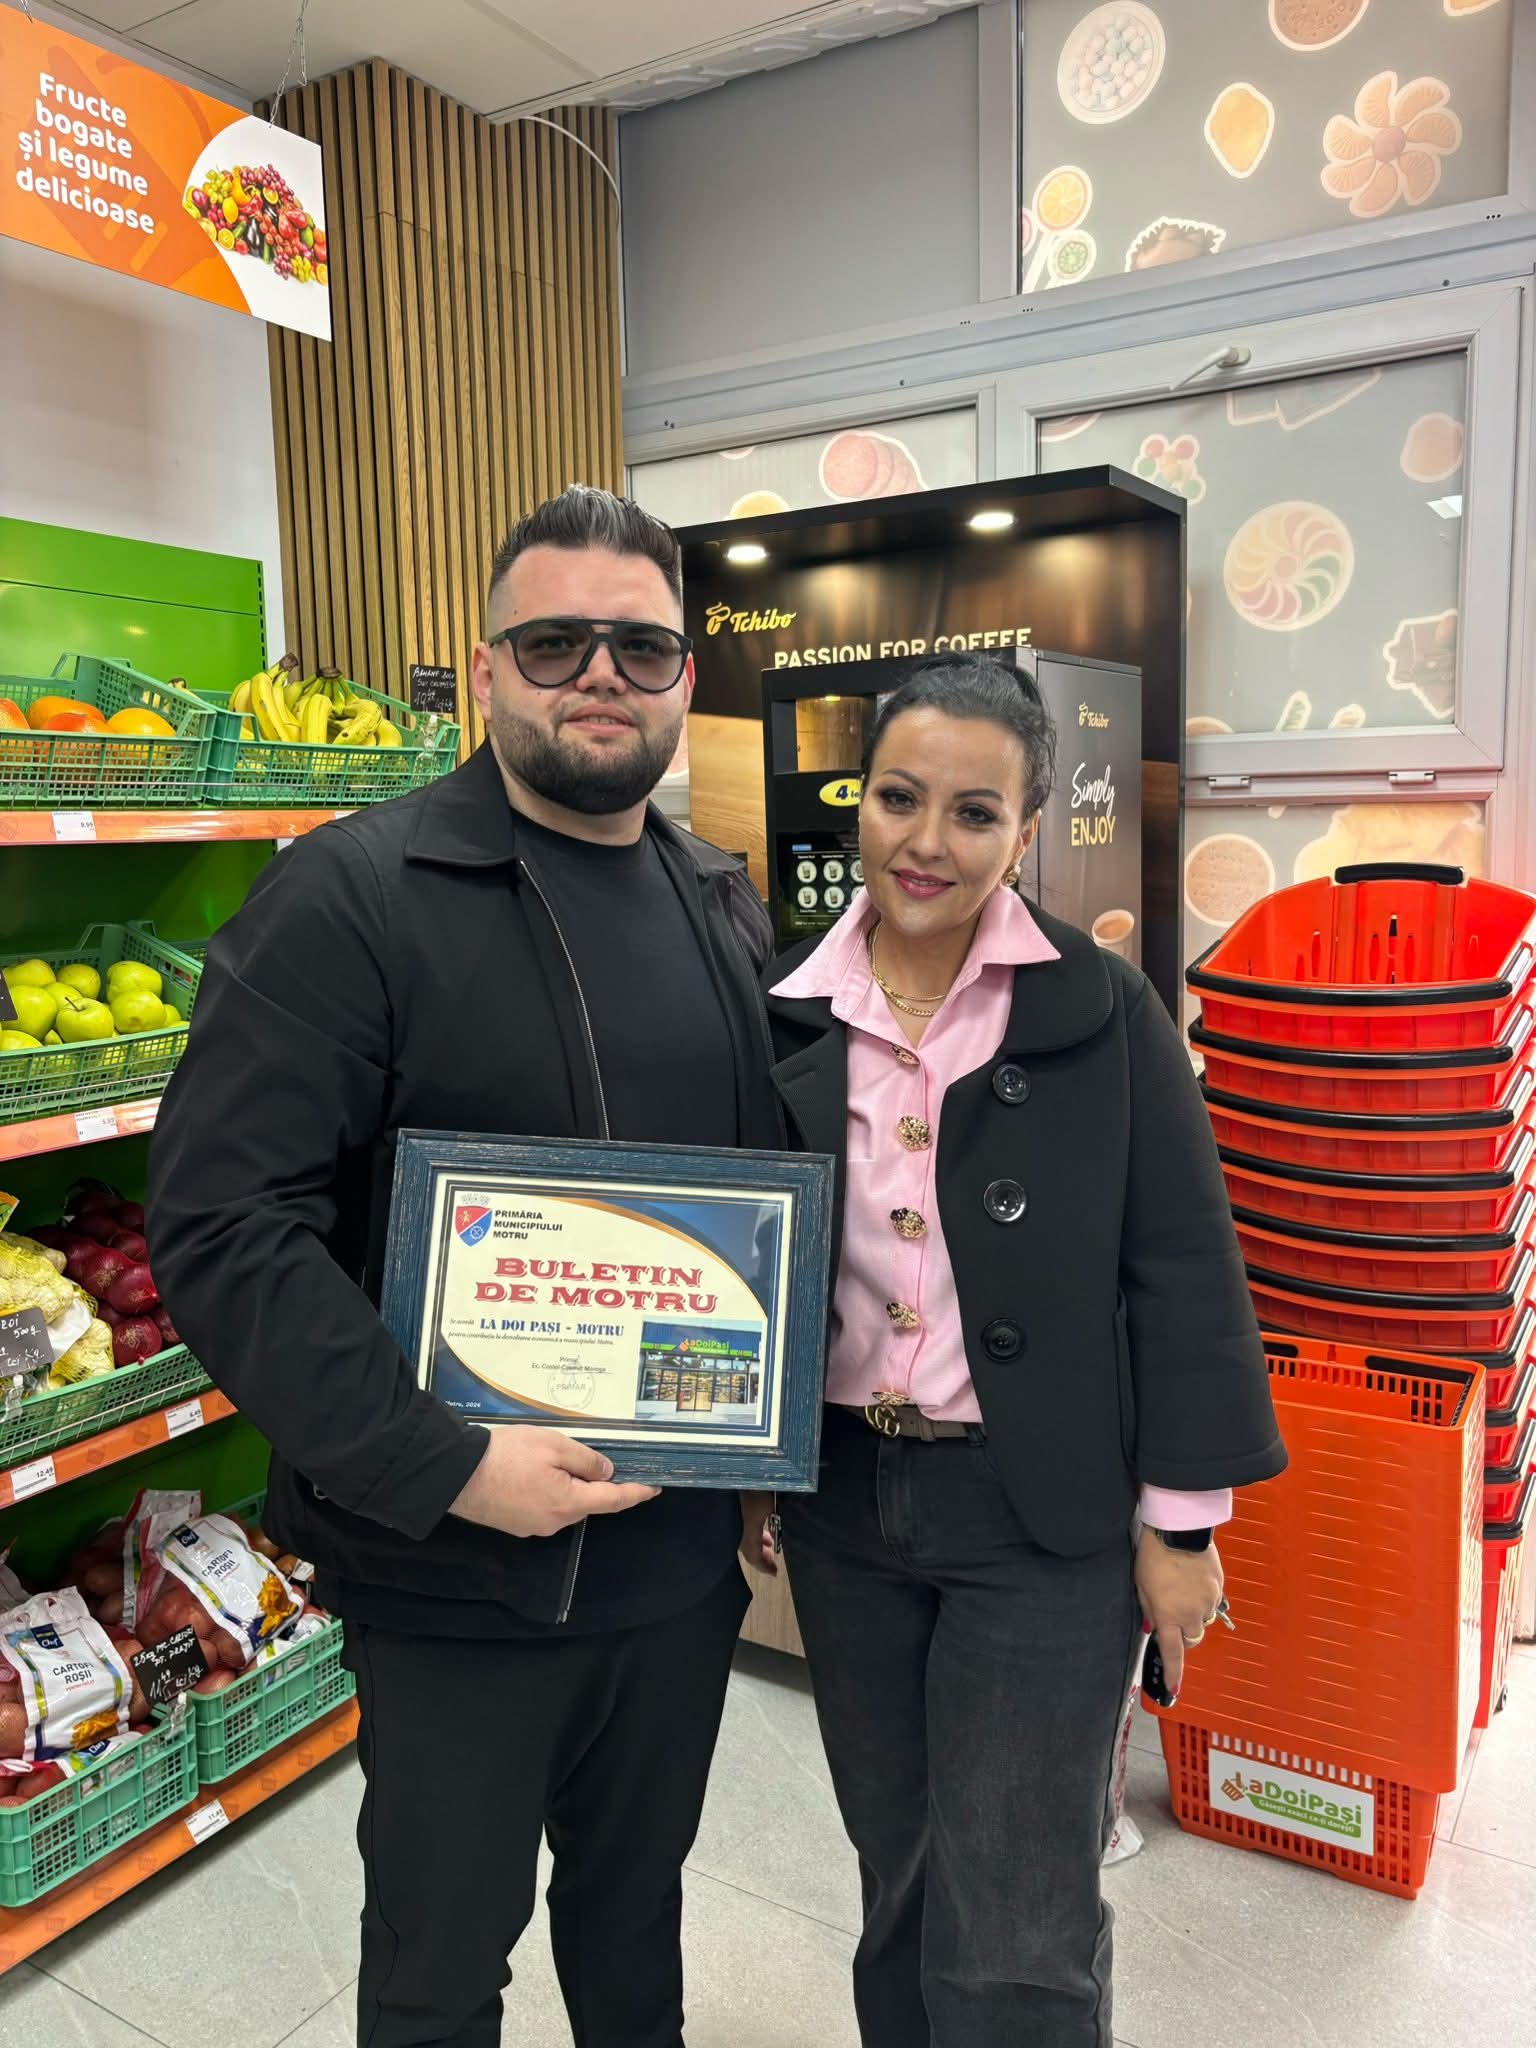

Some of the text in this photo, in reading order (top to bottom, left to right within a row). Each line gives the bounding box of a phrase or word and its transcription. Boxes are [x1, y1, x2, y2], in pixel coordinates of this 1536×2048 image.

[40, 72, 127, 128] Fructe
[36, 98, 132, 159] bogate
[18, 129, 148, 196] și legume
[16, 167, 155, 234] delicioase
[729, 608, 797, 633] Tchibo
[774, 643, 872, 669] PASSION
[879, 639, 926, 659] FOR
[1087, 711, 1110, 728] Tchibo
[835, 785, 849, 801] 4
[1071, 762, 1116, 817] Simply
[1071, 815, 1117, 847] ENJOY
[494, 1220, 563, 1232] MUNICIPIULUI
[495, 1209, 543, 1220] PRIMĂRIA
[493, 1231, 528, 1240] MOTRU
[494, 1257, 703, 1288] BULETIN
[474, 1282, 718, 1314] DE MOTRU
[480, 1318, 497, 1330] LA
[501, 1319, 526, 1332] DOI
[530, 1321, 561, 1336] PAȘI
[576, 1323, 624, 1337] MOTRU
[202, 1549, 233, 1577] CARTOFI
[52, 1662, 95, 1677] CARTOFI
[64, 1669, 92, 1685] ROȘII
